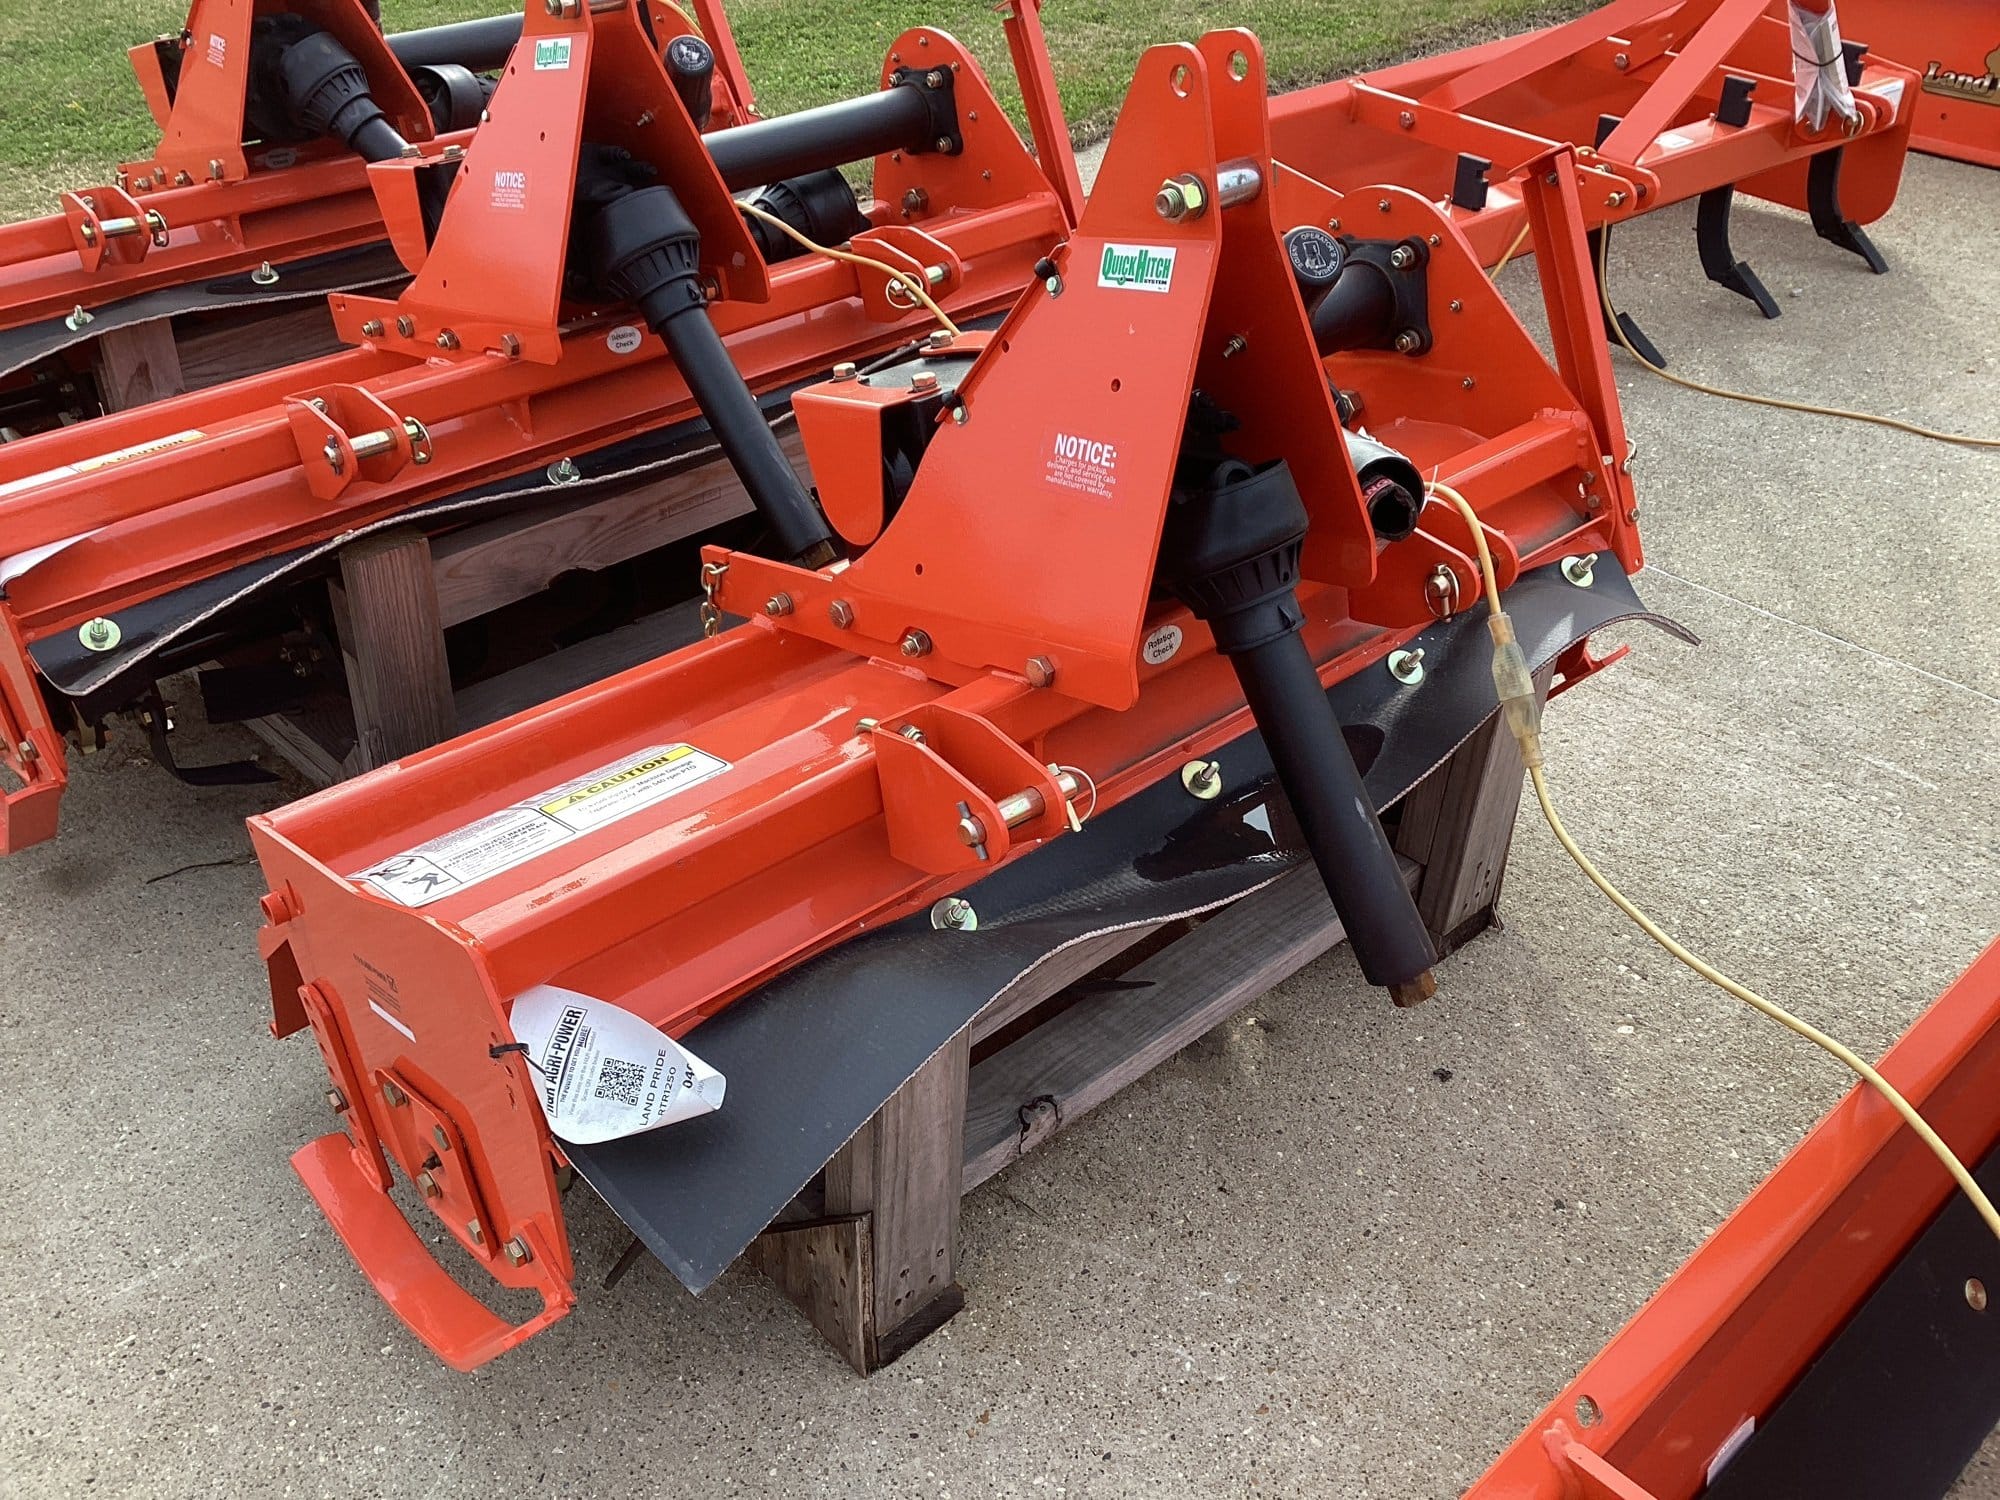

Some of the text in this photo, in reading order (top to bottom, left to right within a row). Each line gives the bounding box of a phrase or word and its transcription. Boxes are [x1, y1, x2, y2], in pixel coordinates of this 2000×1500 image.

[1923, 61, 1994, 94] Land
[615, 341, 634, 349] Check
[1054, 432, 1117, 469] NOTICE:
[1055, 456, 1078, 468] Charges
[1070, 467, 1082, 475] and
[1082, 470, 1103, 480] service
[1103, 475, 1117, 485] calls
[1074, 475, 1097, 487] covered
[1147, 632, 1175, 650] Rotation
[1153, 643, 1174, 657] Check
[586, 756, 670, 794] CAUTION
[545, 1009, 583, 1085] AGRI-POWER
[563, 1073, 574, 1094] POWER
[640, 1048, 667, 1126] LAND PRIDE
[657, 1066, 677, 1116] RTR1250
